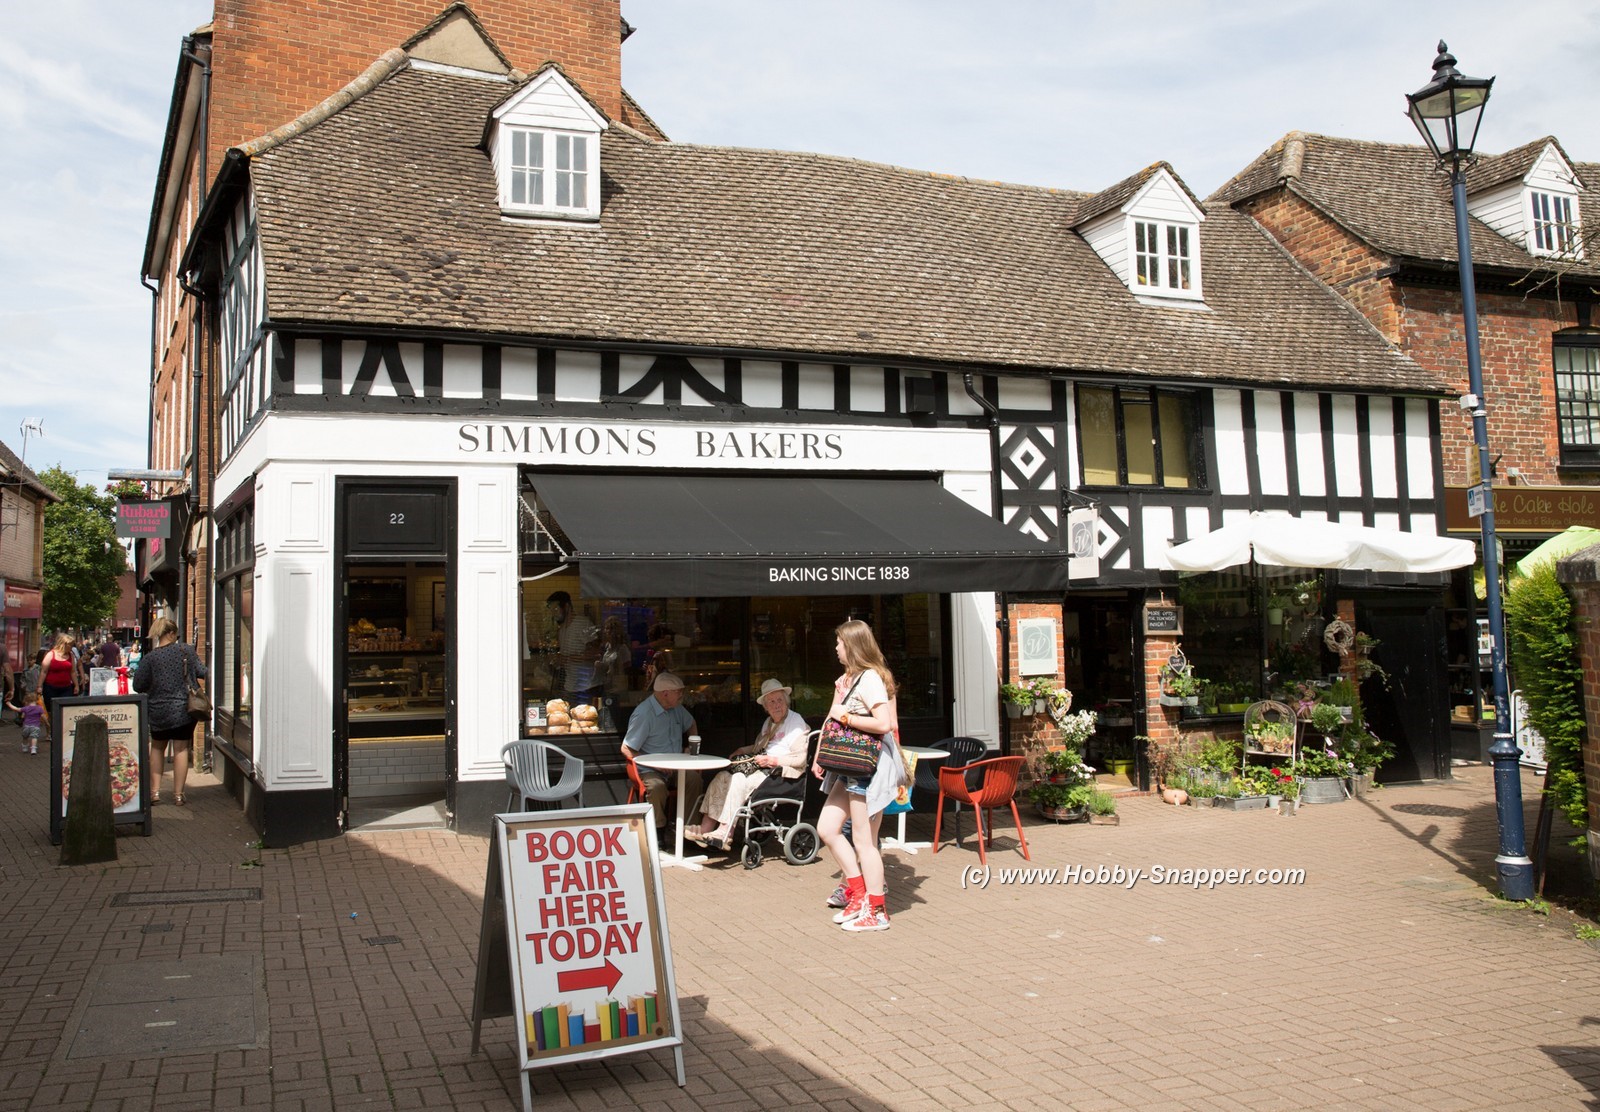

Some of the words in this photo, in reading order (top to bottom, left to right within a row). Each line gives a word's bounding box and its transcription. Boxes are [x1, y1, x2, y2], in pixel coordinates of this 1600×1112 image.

[458, 424, 656, 456] SIMMONS
[696, 430, 843, 459] BAKERS
[119, 503, 169, 518] Rubarb
[389, 512, 405, 524] 22
[1492, 492, 1508, 513] he
[1513, 494, 1553, 514] Cake
[1558, 495, 1595, 515] Hole
[769, 567, 828, 582] BAKING
[831, 566, 876, 581] SINCE
[879, 566, 910, 580] 1838
[110, 713, 128, 722] PIZZA
[526, 827, 627, 863] BOOK
[542, 859, 618, 895] FAIR
[538, 891, 628, 929] HERE
[525, 921, 643, 965] TODAY
